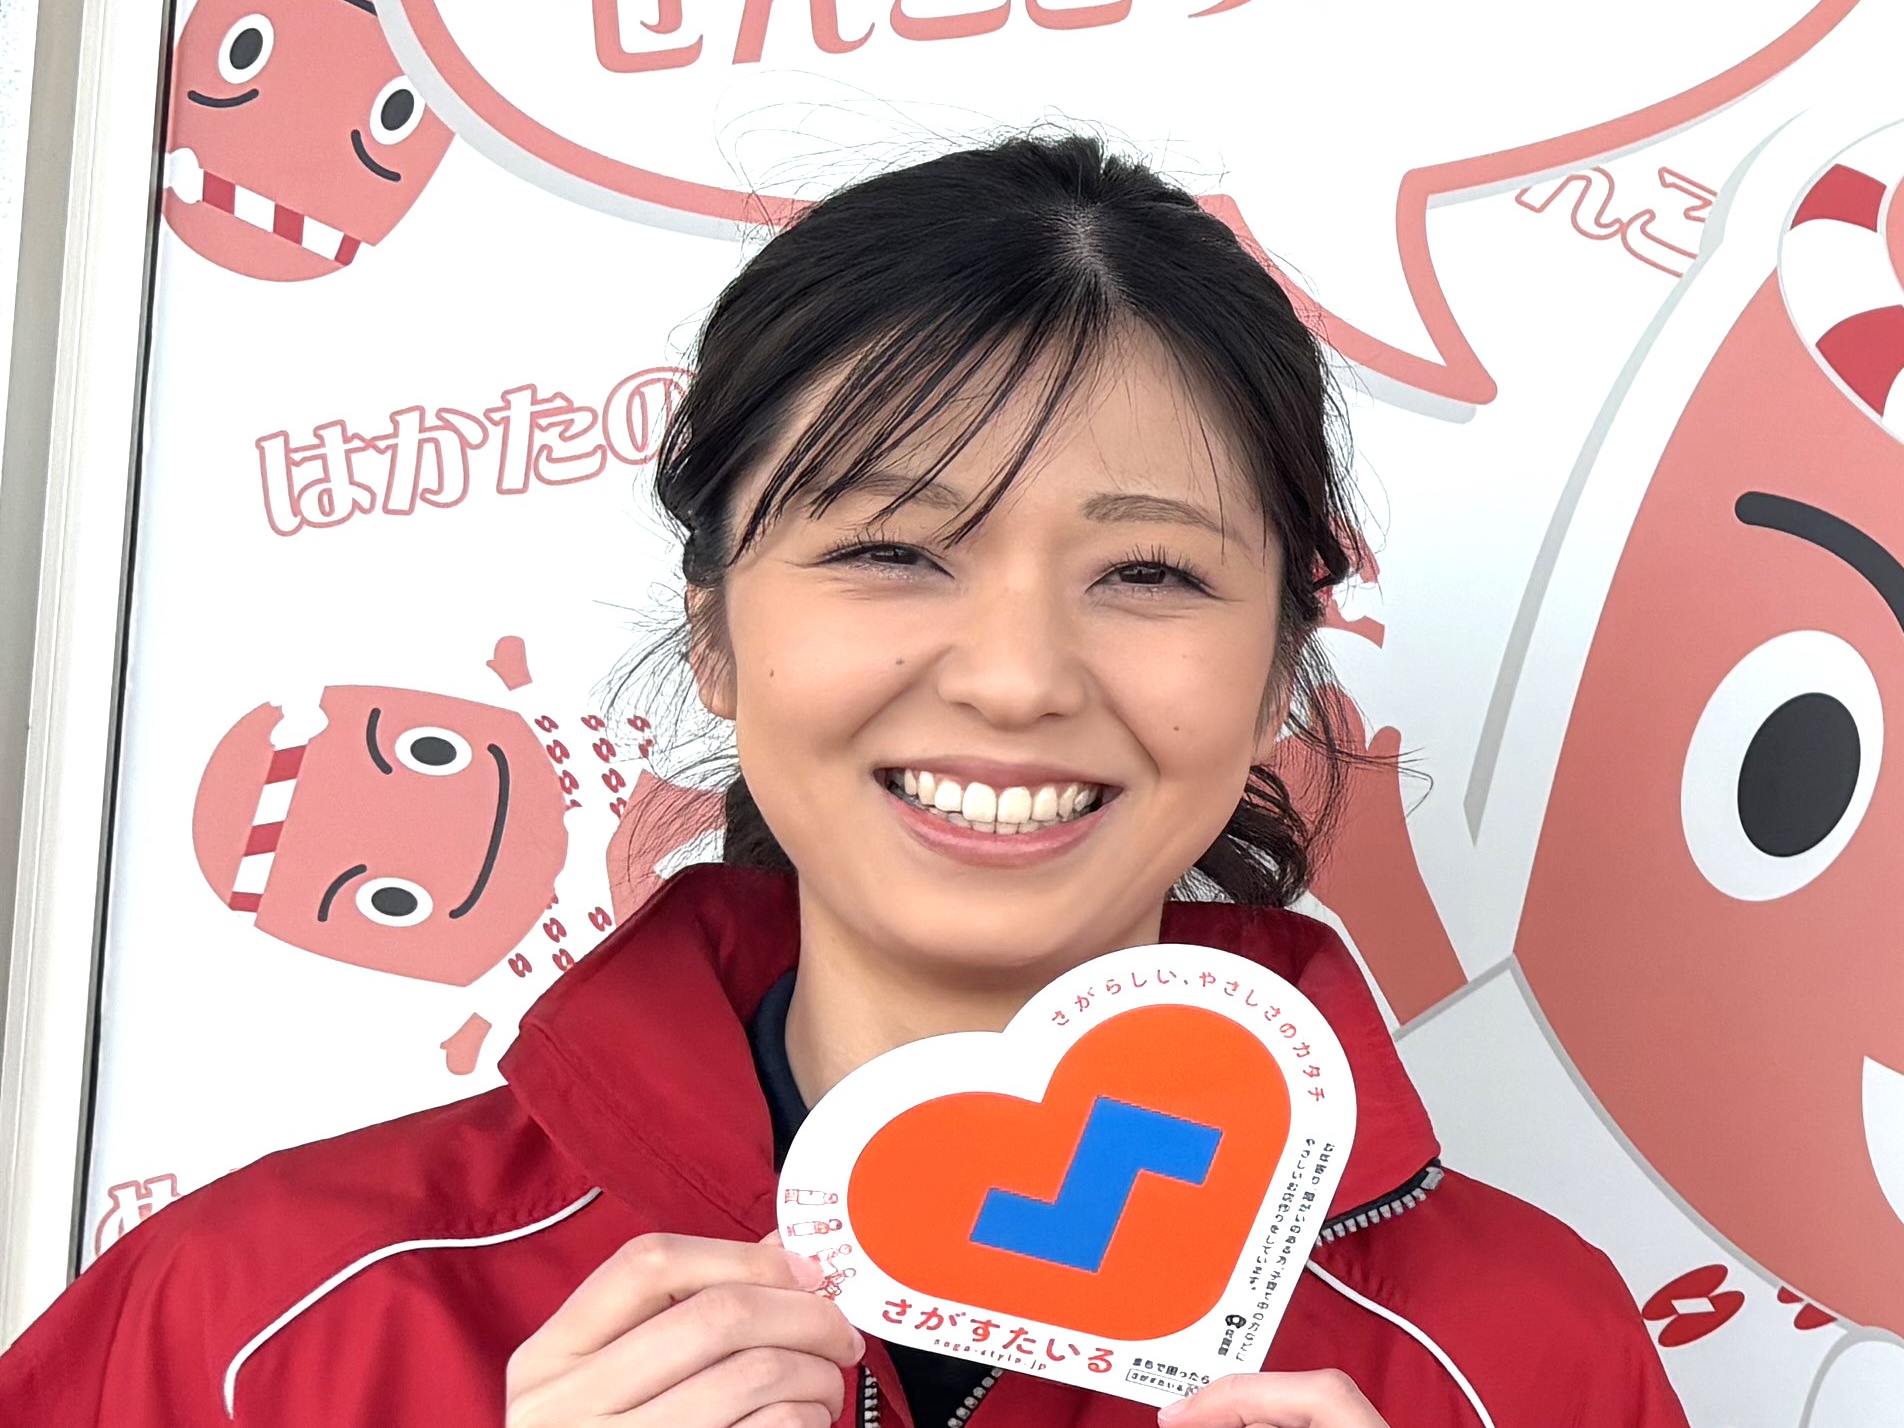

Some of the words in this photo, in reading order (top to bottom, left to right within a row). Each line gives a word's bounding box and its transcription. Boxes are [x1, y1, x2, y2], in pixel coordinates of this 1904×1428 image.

[1051, 968, 1326, 1103] さがらしい、やさしさのカタチ
[882, 1299, 1115, 1374] さがすたいる
